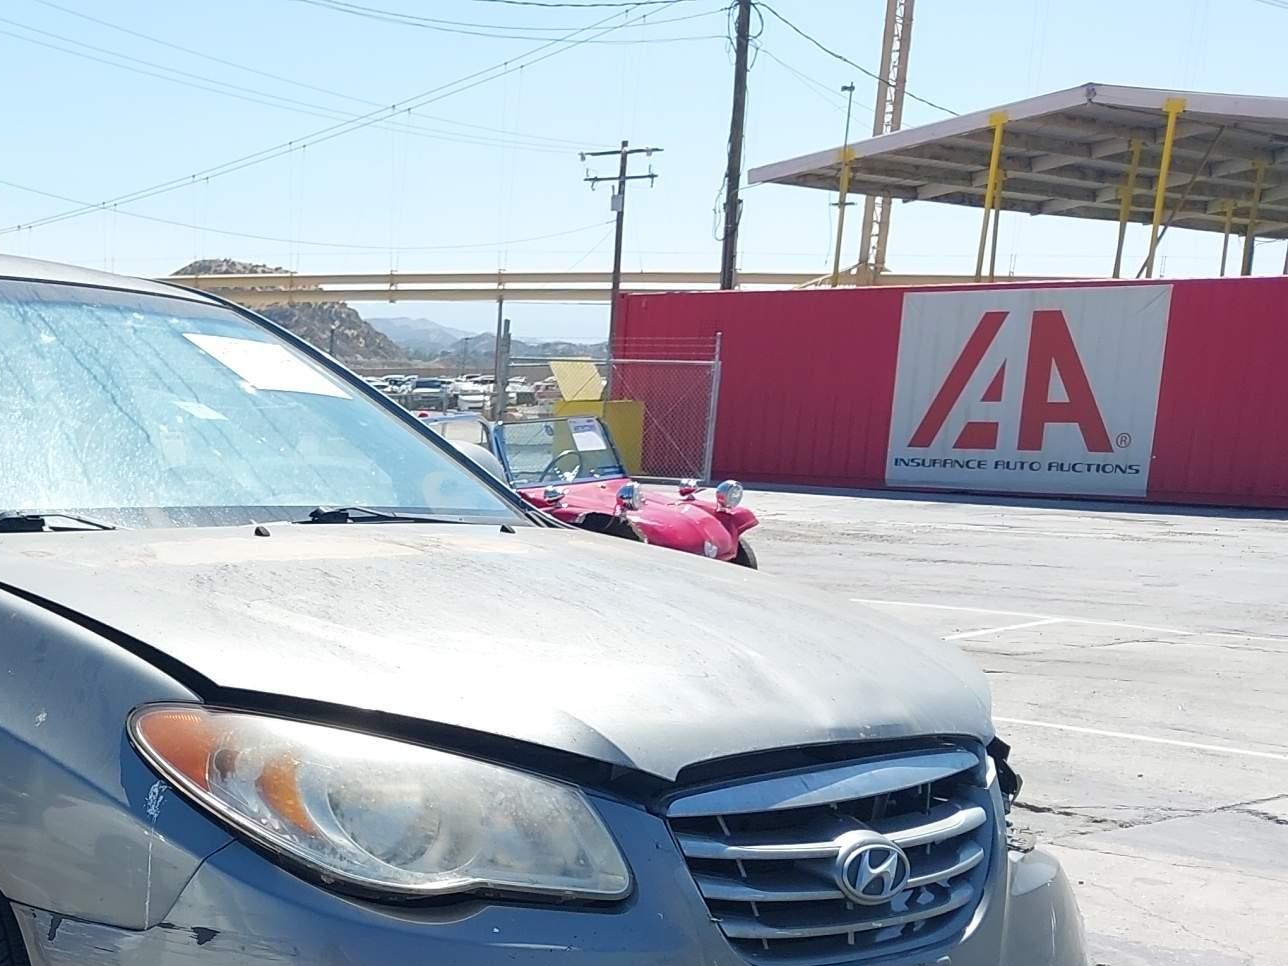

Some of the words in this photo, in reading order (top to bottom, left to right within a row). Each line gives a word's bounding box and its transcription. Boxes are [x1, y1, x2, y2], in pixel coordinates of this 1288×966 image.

[893, 457, 988, 471] INSURANCE
[993, 460, 1042, 472] AUTO
[1047, 462, 1142, 475] AUCTIONS
